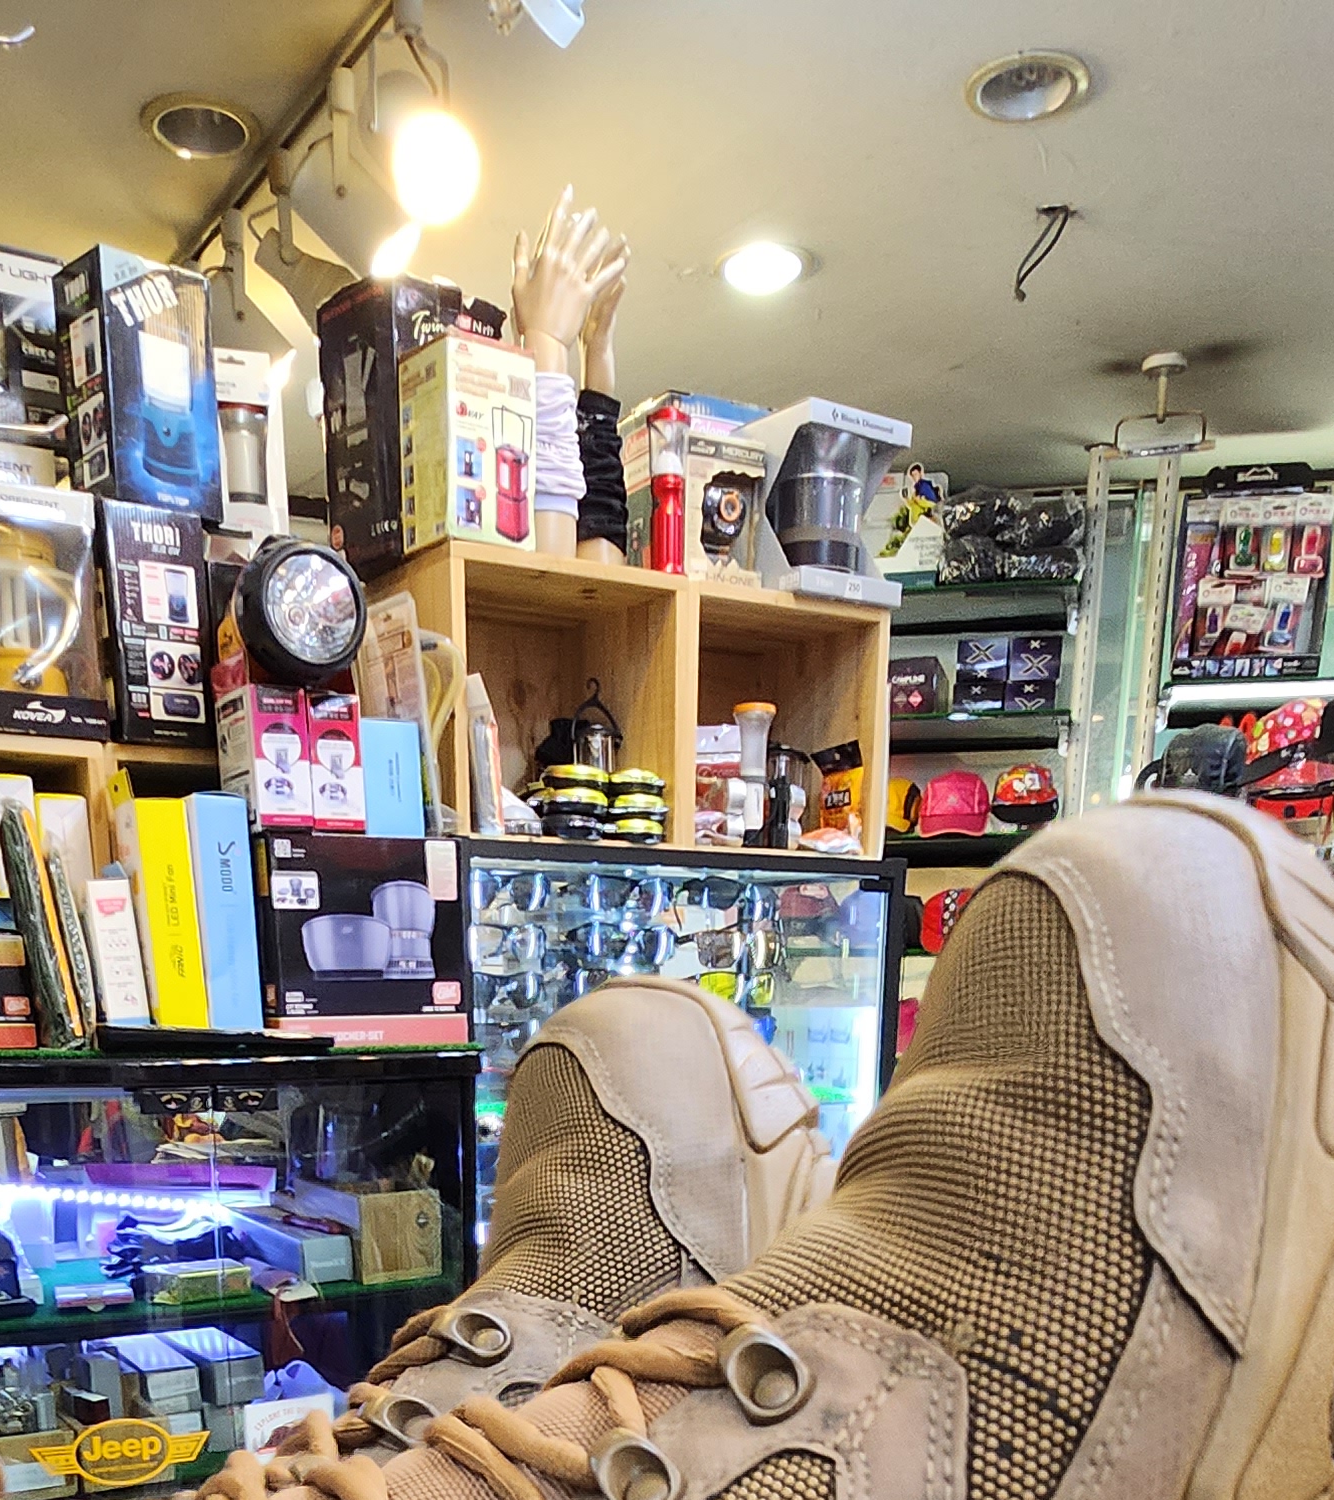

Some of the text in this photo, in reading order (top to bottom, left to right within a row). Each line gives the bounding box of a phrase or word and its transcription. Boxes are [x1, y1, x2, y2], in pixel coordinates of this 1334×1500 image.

[841, 413, 894, 434] Black Diamond
[721, 445, 765, 463] MERCURY
[848, 582, 861, 594] 250
[167, 864, 180, 927] LED Mini Fan
[83, 1436, 161, 1462] Jeep
